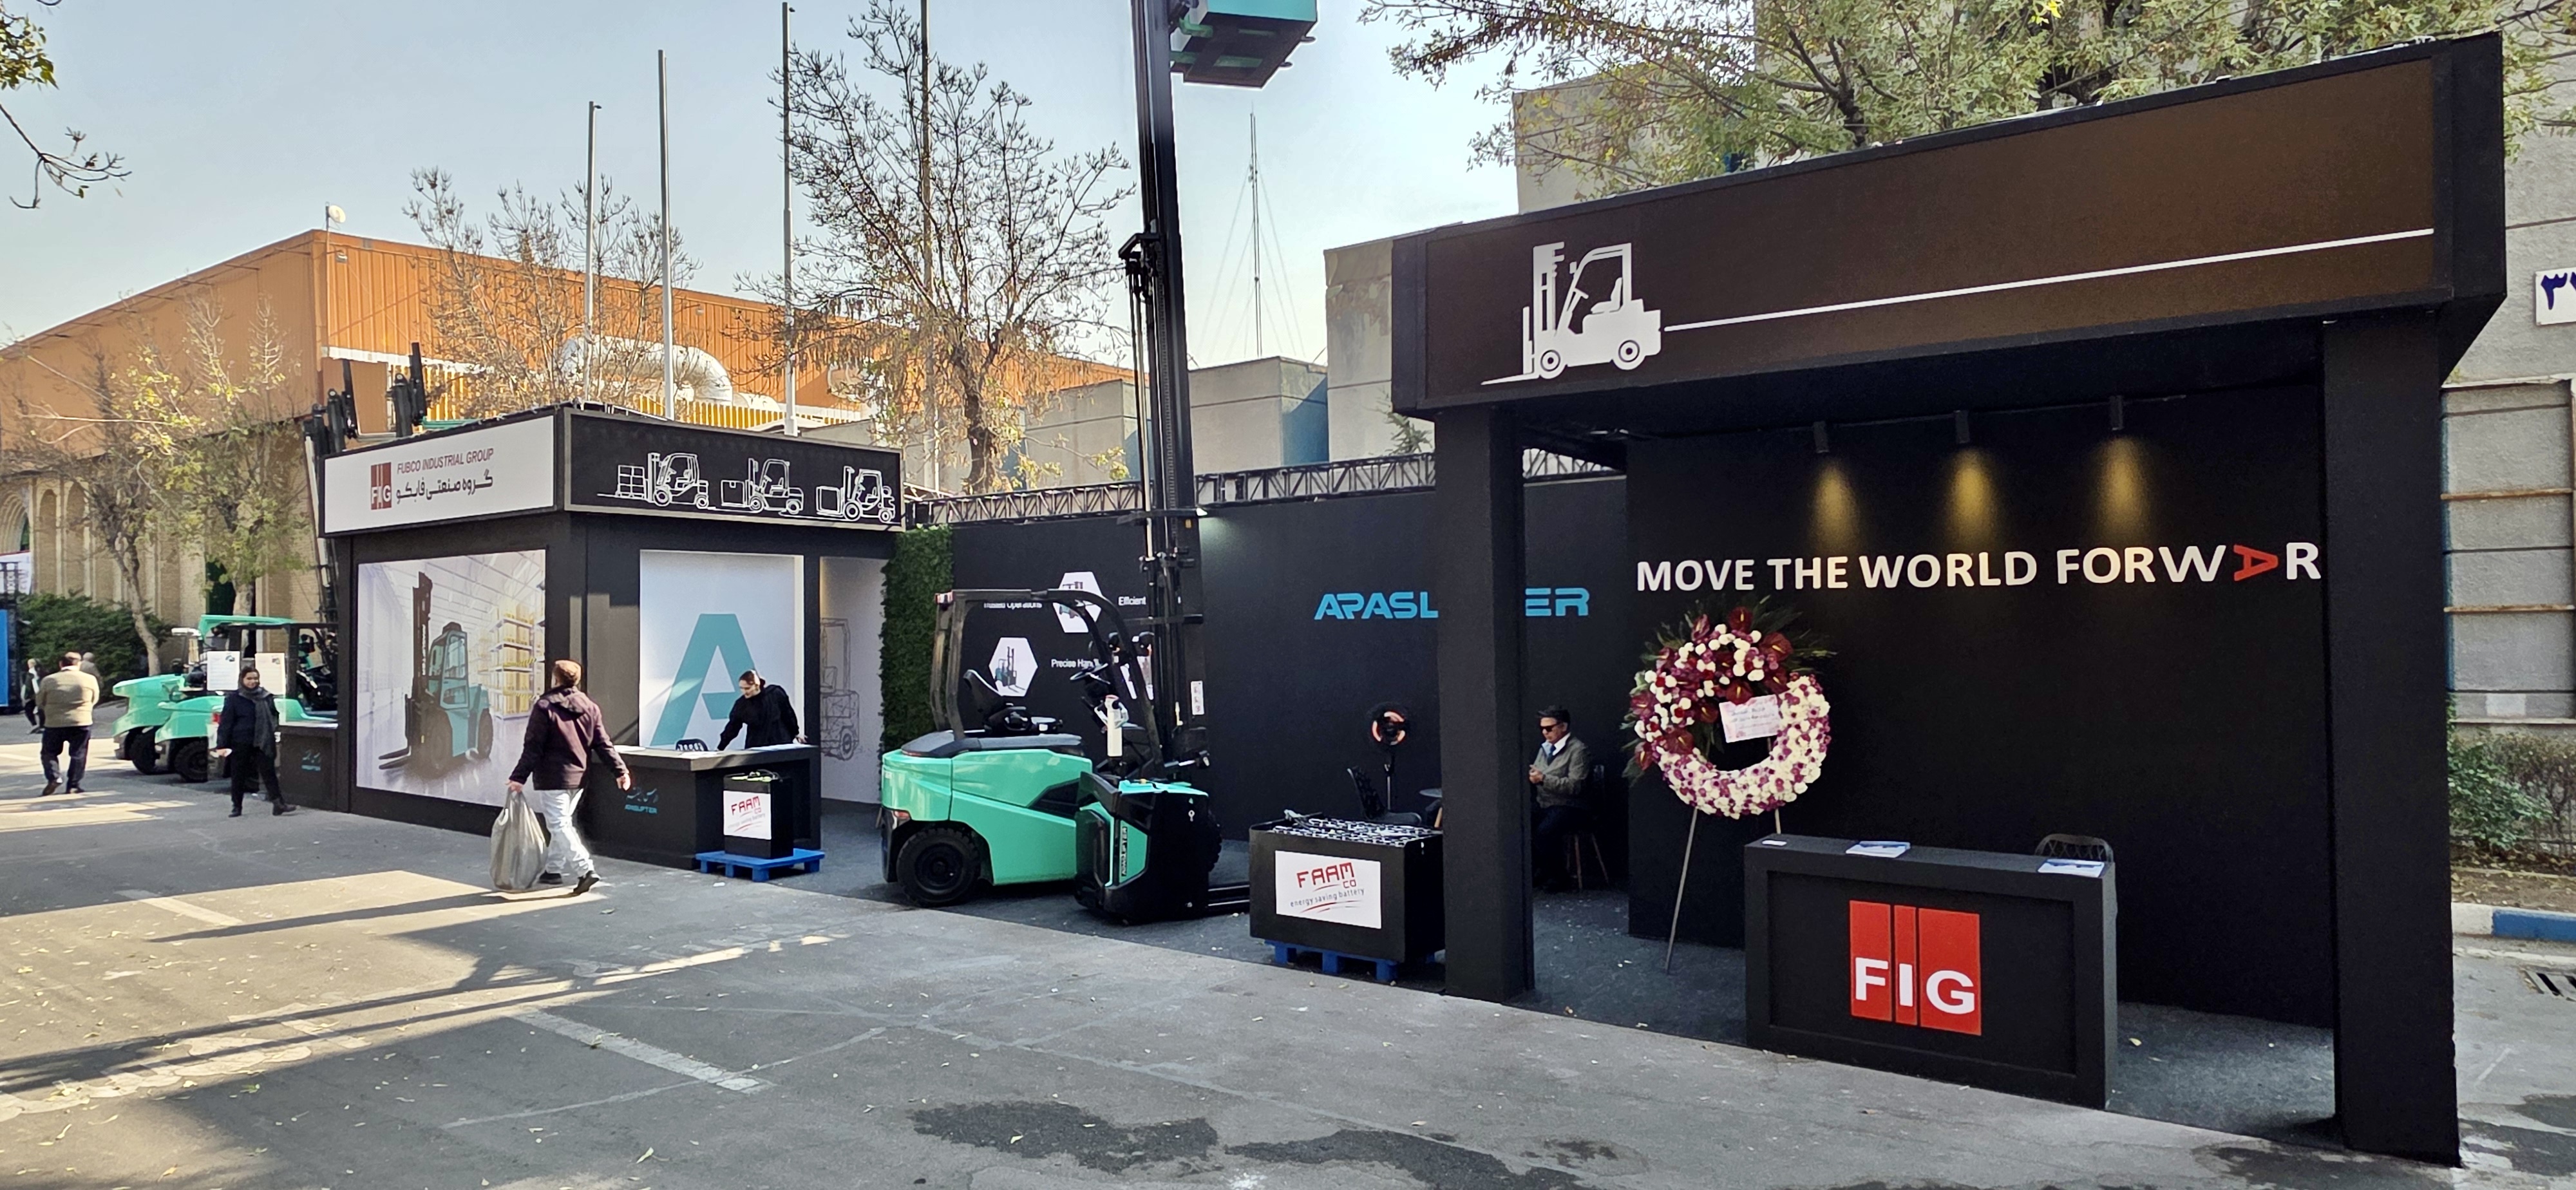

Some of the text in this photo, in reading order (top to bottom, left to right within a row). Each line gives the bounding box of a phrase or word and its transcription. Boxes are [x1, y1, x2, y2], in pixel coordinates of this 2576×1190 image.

[2541, 271, 2576, 310] ۳
[397, 448, 494, 474] FUBCO INDUSTRIAL GROUP
[372, 484, 391, 504] FIG
[396, 469, 493, 504] گروه صنعتی فابکو
[1637, 542, 2322, 591] MOVE THE WORLD FORWAR
[1314, 587, 1590, 620] APASLER
[731, 796, 761, 816] FAAM
[1296, 862, 1354, 888] FAAM
[1290, 888, 1365, 907] energy saving battery
[1855, 956, 1975, 1015] FIG
